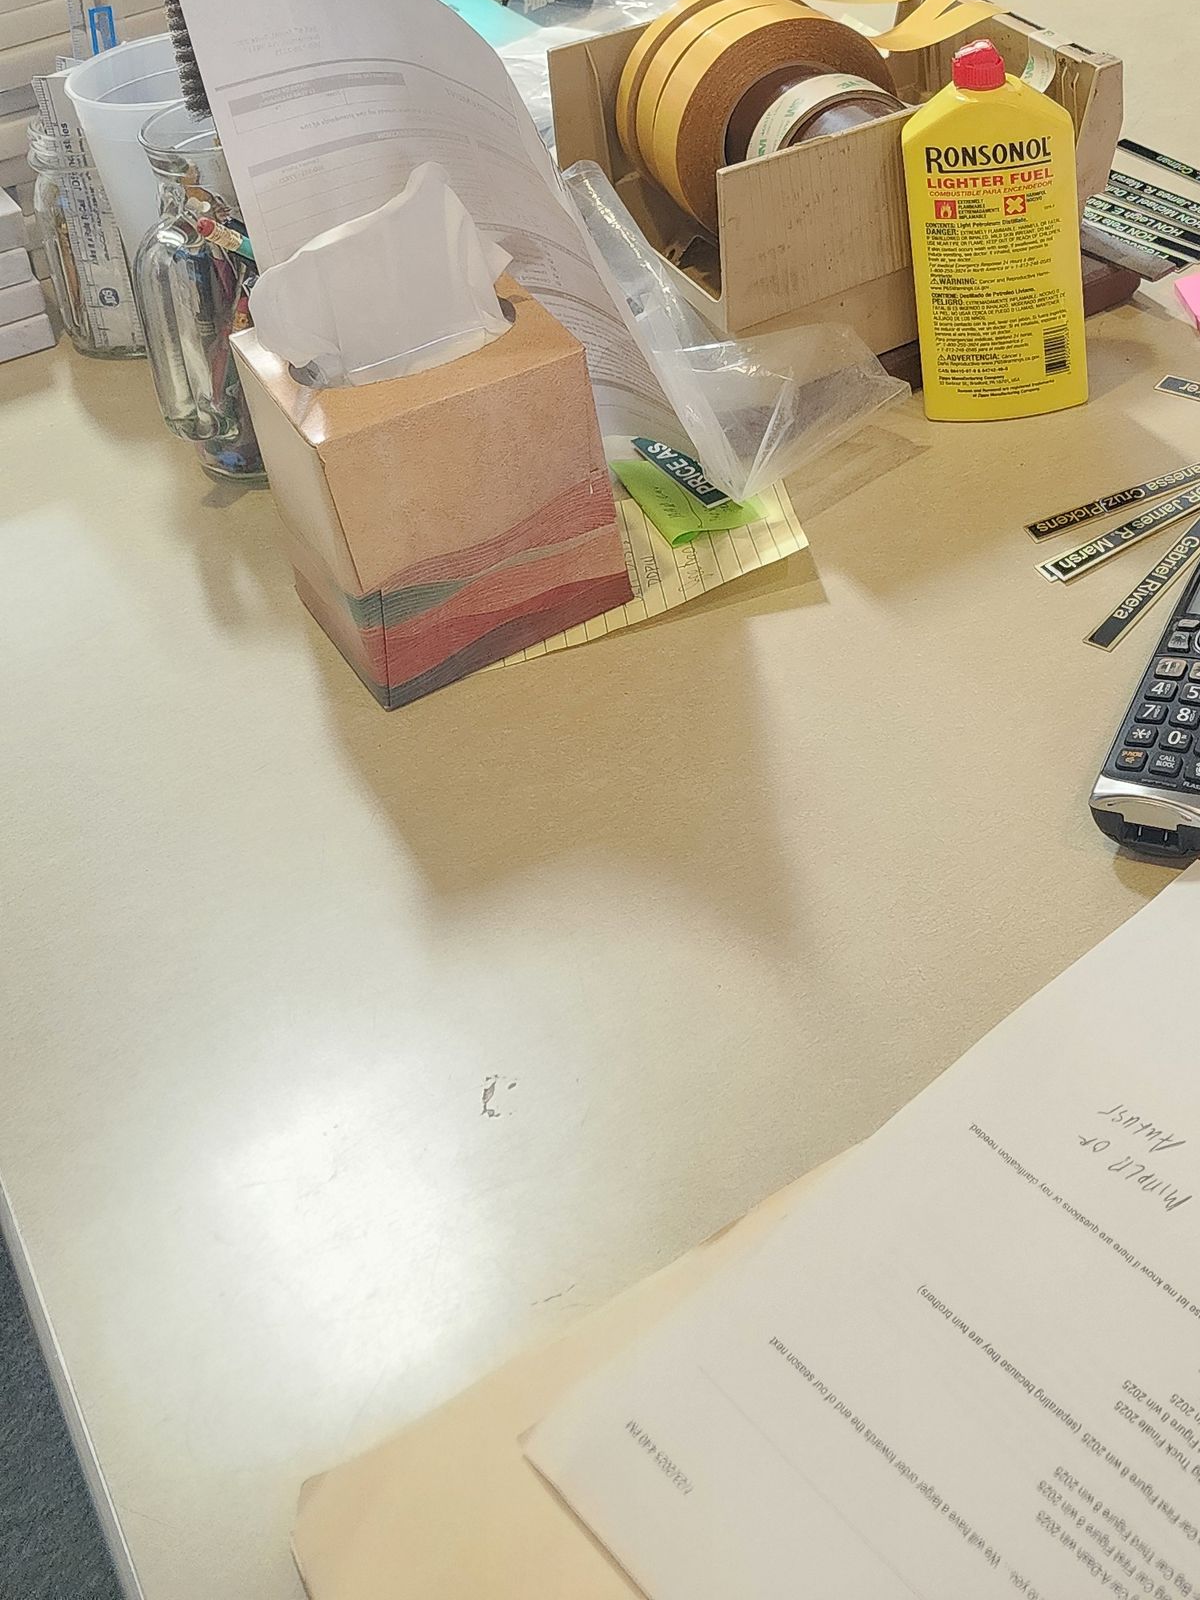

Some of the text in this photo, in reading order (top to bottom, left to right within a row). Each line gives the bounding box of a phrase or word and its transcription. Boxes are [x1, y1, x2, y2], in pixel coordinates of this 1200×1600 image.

[923, 136, 1051, 174] RONSONOL
[926, 167, 1054, 191] LIGHTER FUEL
[1111, 173, 1143, 188] Marsh
[928, 182, 1053, 199] COMBUSTIBLE PARA ENCENDEDOR
[1156, 190, 1189, 205] James
[1138, 198, 1178, 216] Michael
[924, 221, 956, 229] CONTENTS:
[972, 218, 1001, 226] Petroleum
[925, 226, 959, 237] DANGER:
[1154, 222, 1183, 236] HON
[1125, 228, 1156, 243] HON
[938, 276, 977, 286] WARNING:
[945, 353, 1000, 362] ADVERTENCIA:
[647, 439, 715, 493] PRICE AS
[1132, 499, 1182, 528] James
[1110, 527, 1134, 538] R.
[1059, 538, 1113, 567] Marsh
[1113, 536, 1199, 618] Gabriel Rivera
[1163, 659, 1173, 674] 1
[1150, 680, 1165, 695] 4
[1186, 684, 1200, 700] 5
[1141, 702, 1156, 719] 7
[1175, 706, 1191, 722] 8
[1166, 729, 1181, 745] 0
[1155, 759, 1174, 769] BLOCK
[1158, 754, 1176, 763] CALL
[997, 1148, 1038, 1183] clarification
[1062, 1202, 1098, 1233] questions
[1098, 1232, 1113, 1244] are
[1113, 1243, 1134, 1263] there
[1140, 1266, 1163, 1286] know
[1162, 1283, 1177, 1296] me
[1175, 1295, 1189, 1308] let
[917, 1285, 1035, 1393] because they are twin brothers)
